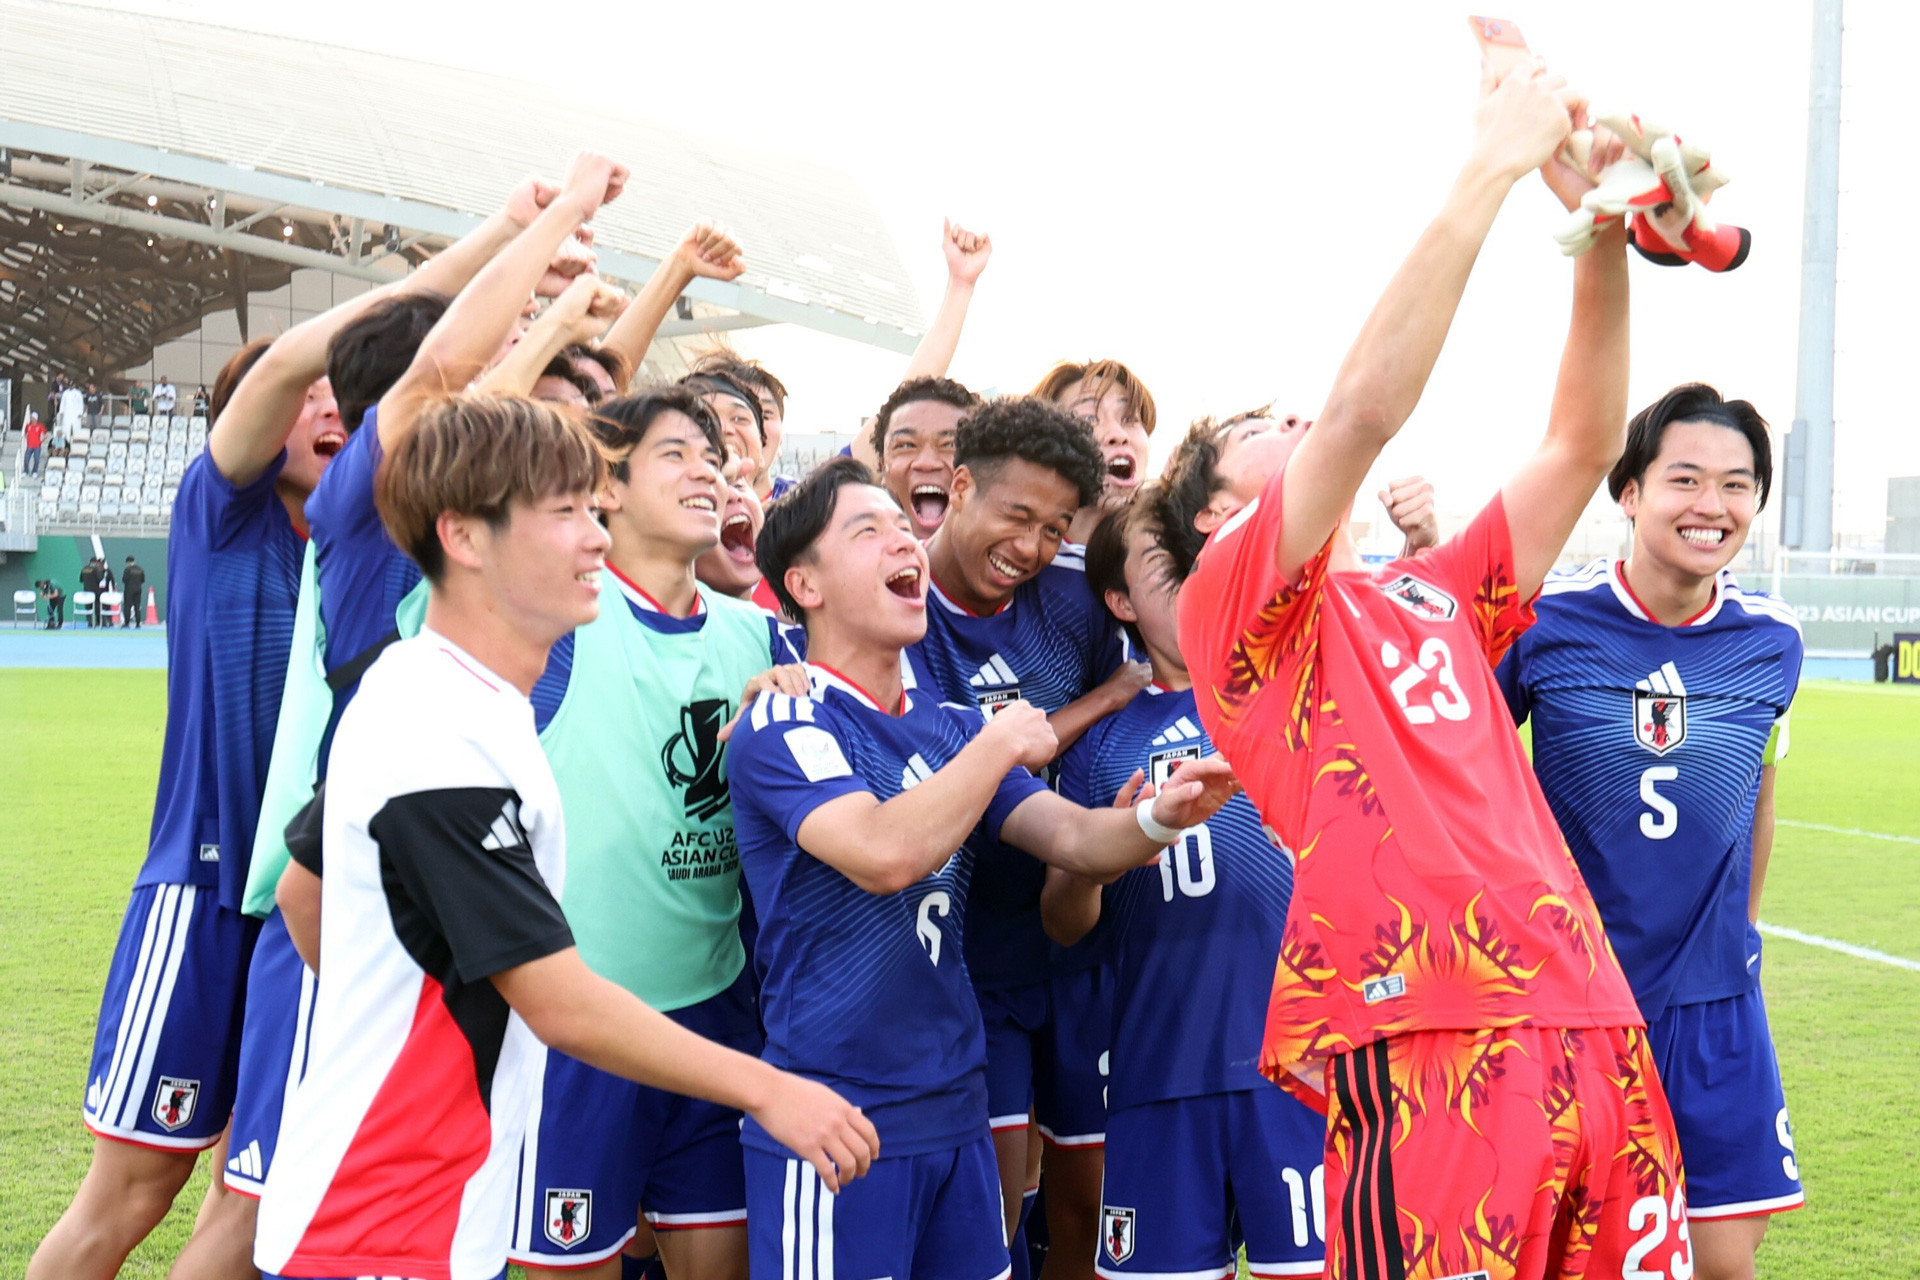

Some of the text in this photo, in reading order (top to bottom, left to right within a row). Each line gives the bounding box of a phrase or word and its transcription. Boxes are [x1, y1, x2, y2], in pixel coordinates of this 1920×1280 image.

[1791, 605, 1920, 623] 23 ASIAN CUP
[1380, 637, 1471, 725] 23
[984, 693, 1008, 704] JAPAN
[1162, 750, 1188, 760] JAPAN
[1639, 766, 1679, 840] 5
[671, 827, 736, 847] AFC U2
[662, 849, 716, 867] ASIAN
[1159, 822, 1217, 903] 10
[694, 865, 721, 878] ARABIA
[1621, 1184, 1694, 1280] 23
